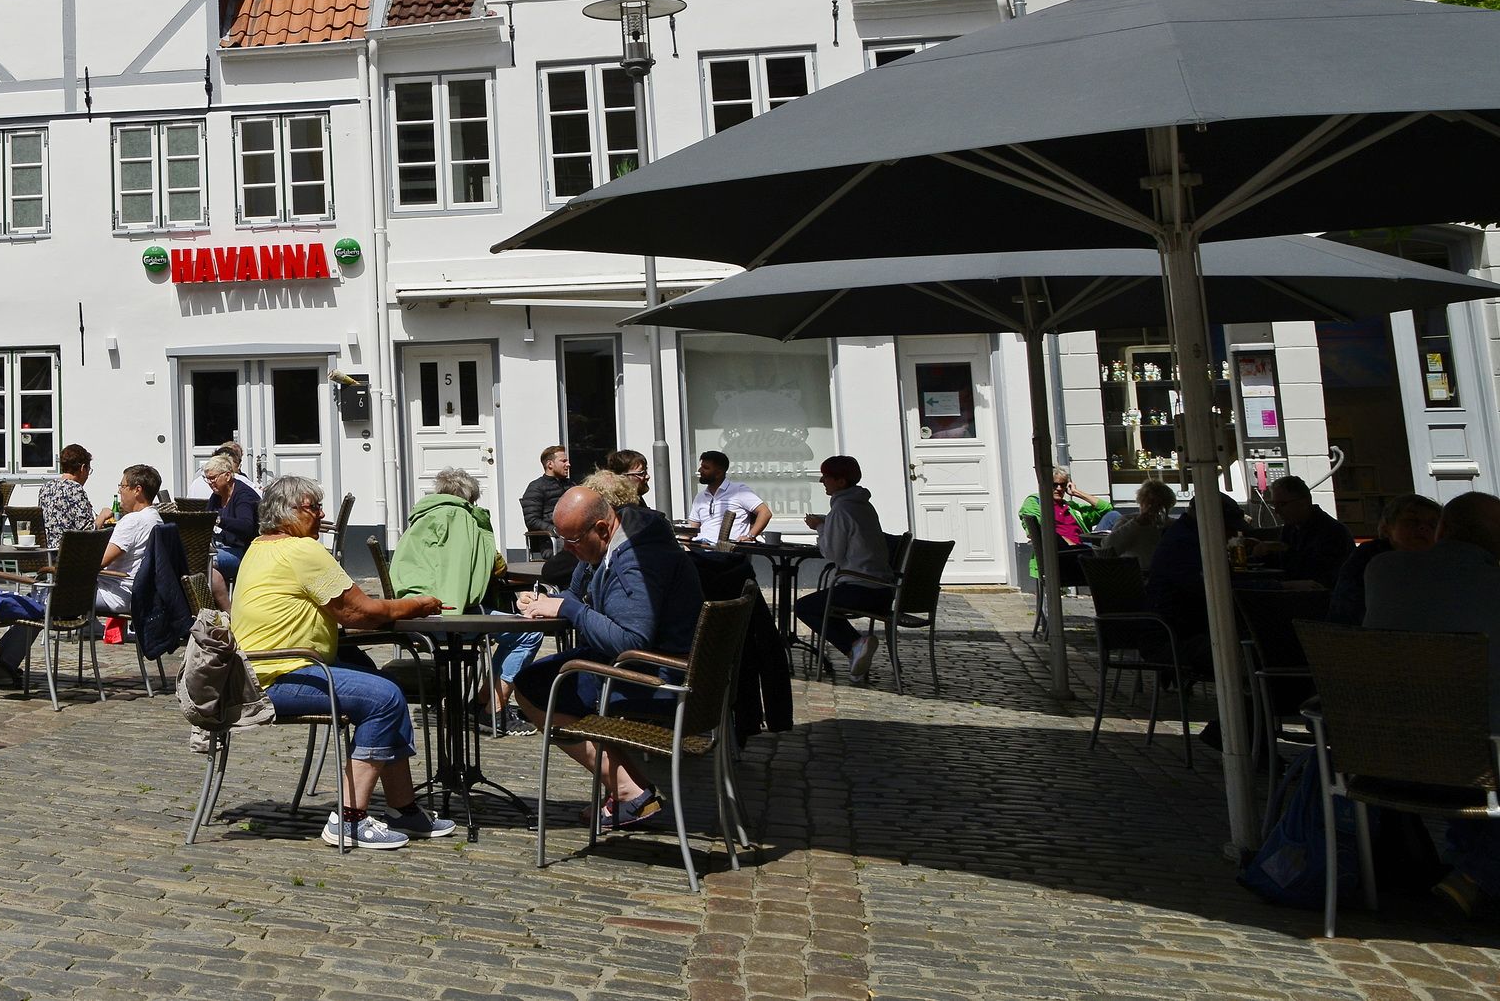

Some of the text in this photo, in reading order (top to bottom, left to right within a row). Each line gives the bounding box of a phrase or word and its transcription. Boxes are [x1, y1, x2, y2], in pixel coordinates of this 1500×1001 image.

[171, 243, 331, 284] HAVANNA
[444, 373, 452, 386] 5
[358, 397, 364, 408] 6
